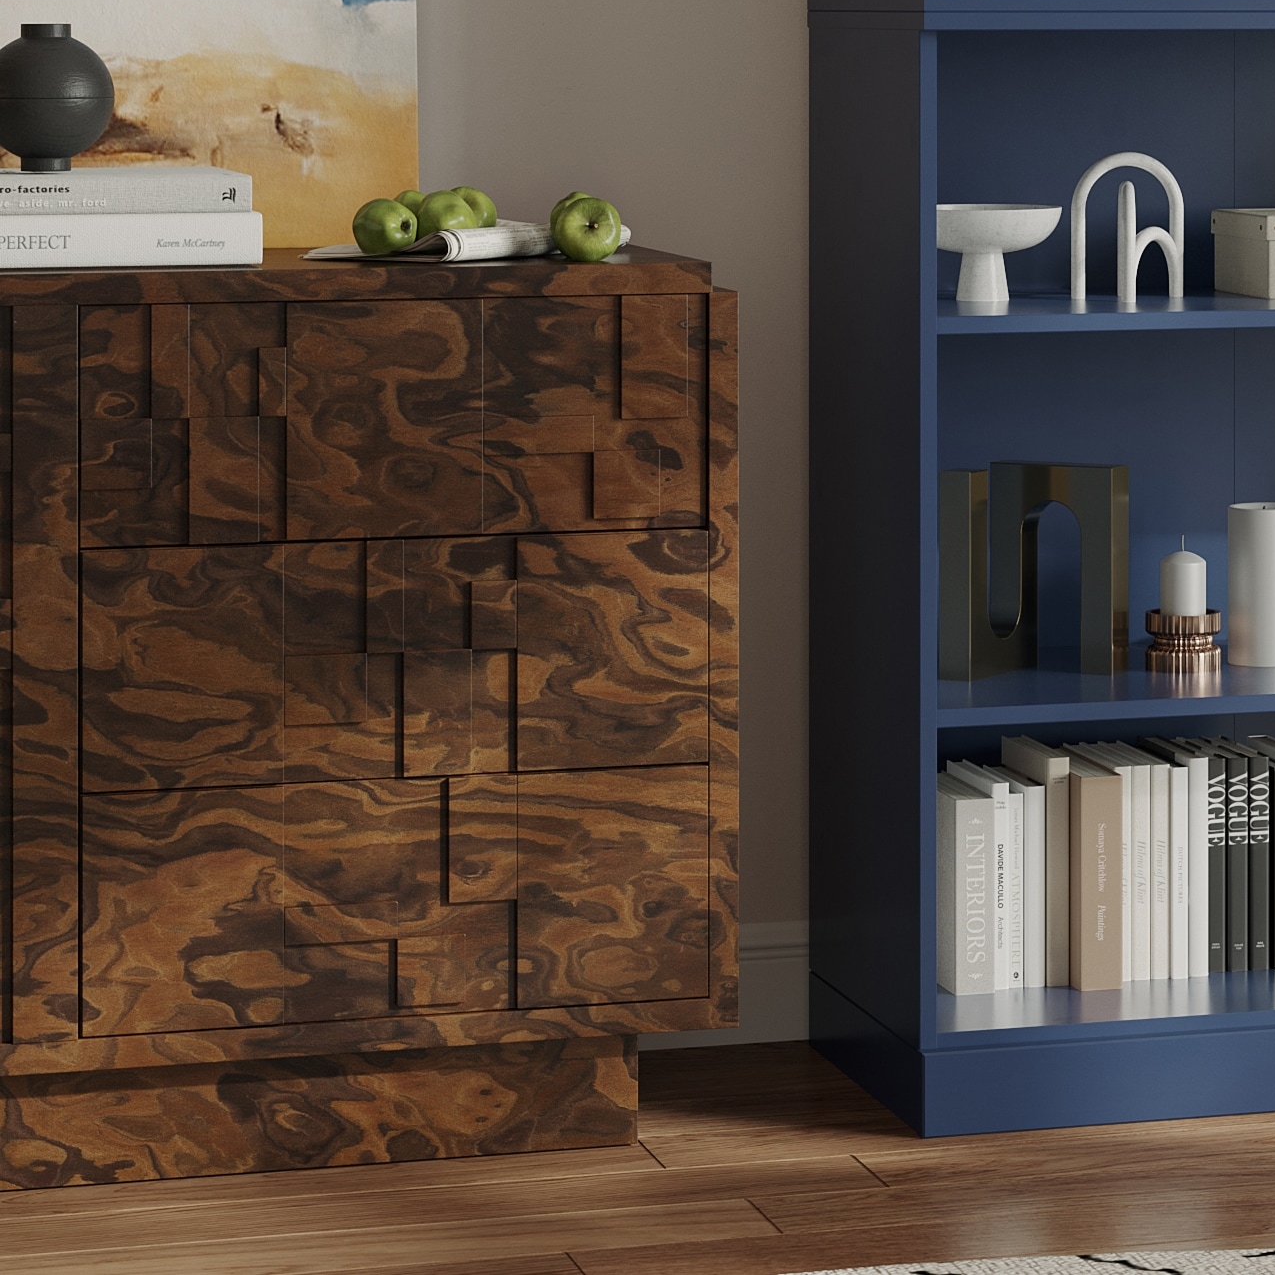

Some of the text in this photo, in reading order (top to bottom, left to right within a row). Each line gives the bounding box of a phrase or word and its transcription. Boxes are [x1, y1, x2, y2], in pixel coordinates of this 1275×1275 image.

[19, 198, 53, 208] aside,
[58, 199, 77, 207] mr.
[82, 197, 107, 207] ford
[156, 238, 226, 250] Karen McCartney
[1208, 772, 1226, 847] VOGUE
[1228, 772, 1248, 846] VOGUE
[1250, 771, 1270, 845] VOGUE
[966, 833, 986, 964] INTERIORS
[1095, 823, 1107, 941] Somaya Critchlow Paintings
[1137, 840, 1146, 904] Hilma Klint
[1156, 839, 1166, 903] Hilma Klint
[1011, 874, 1021, 968] ATMOSPHERE
